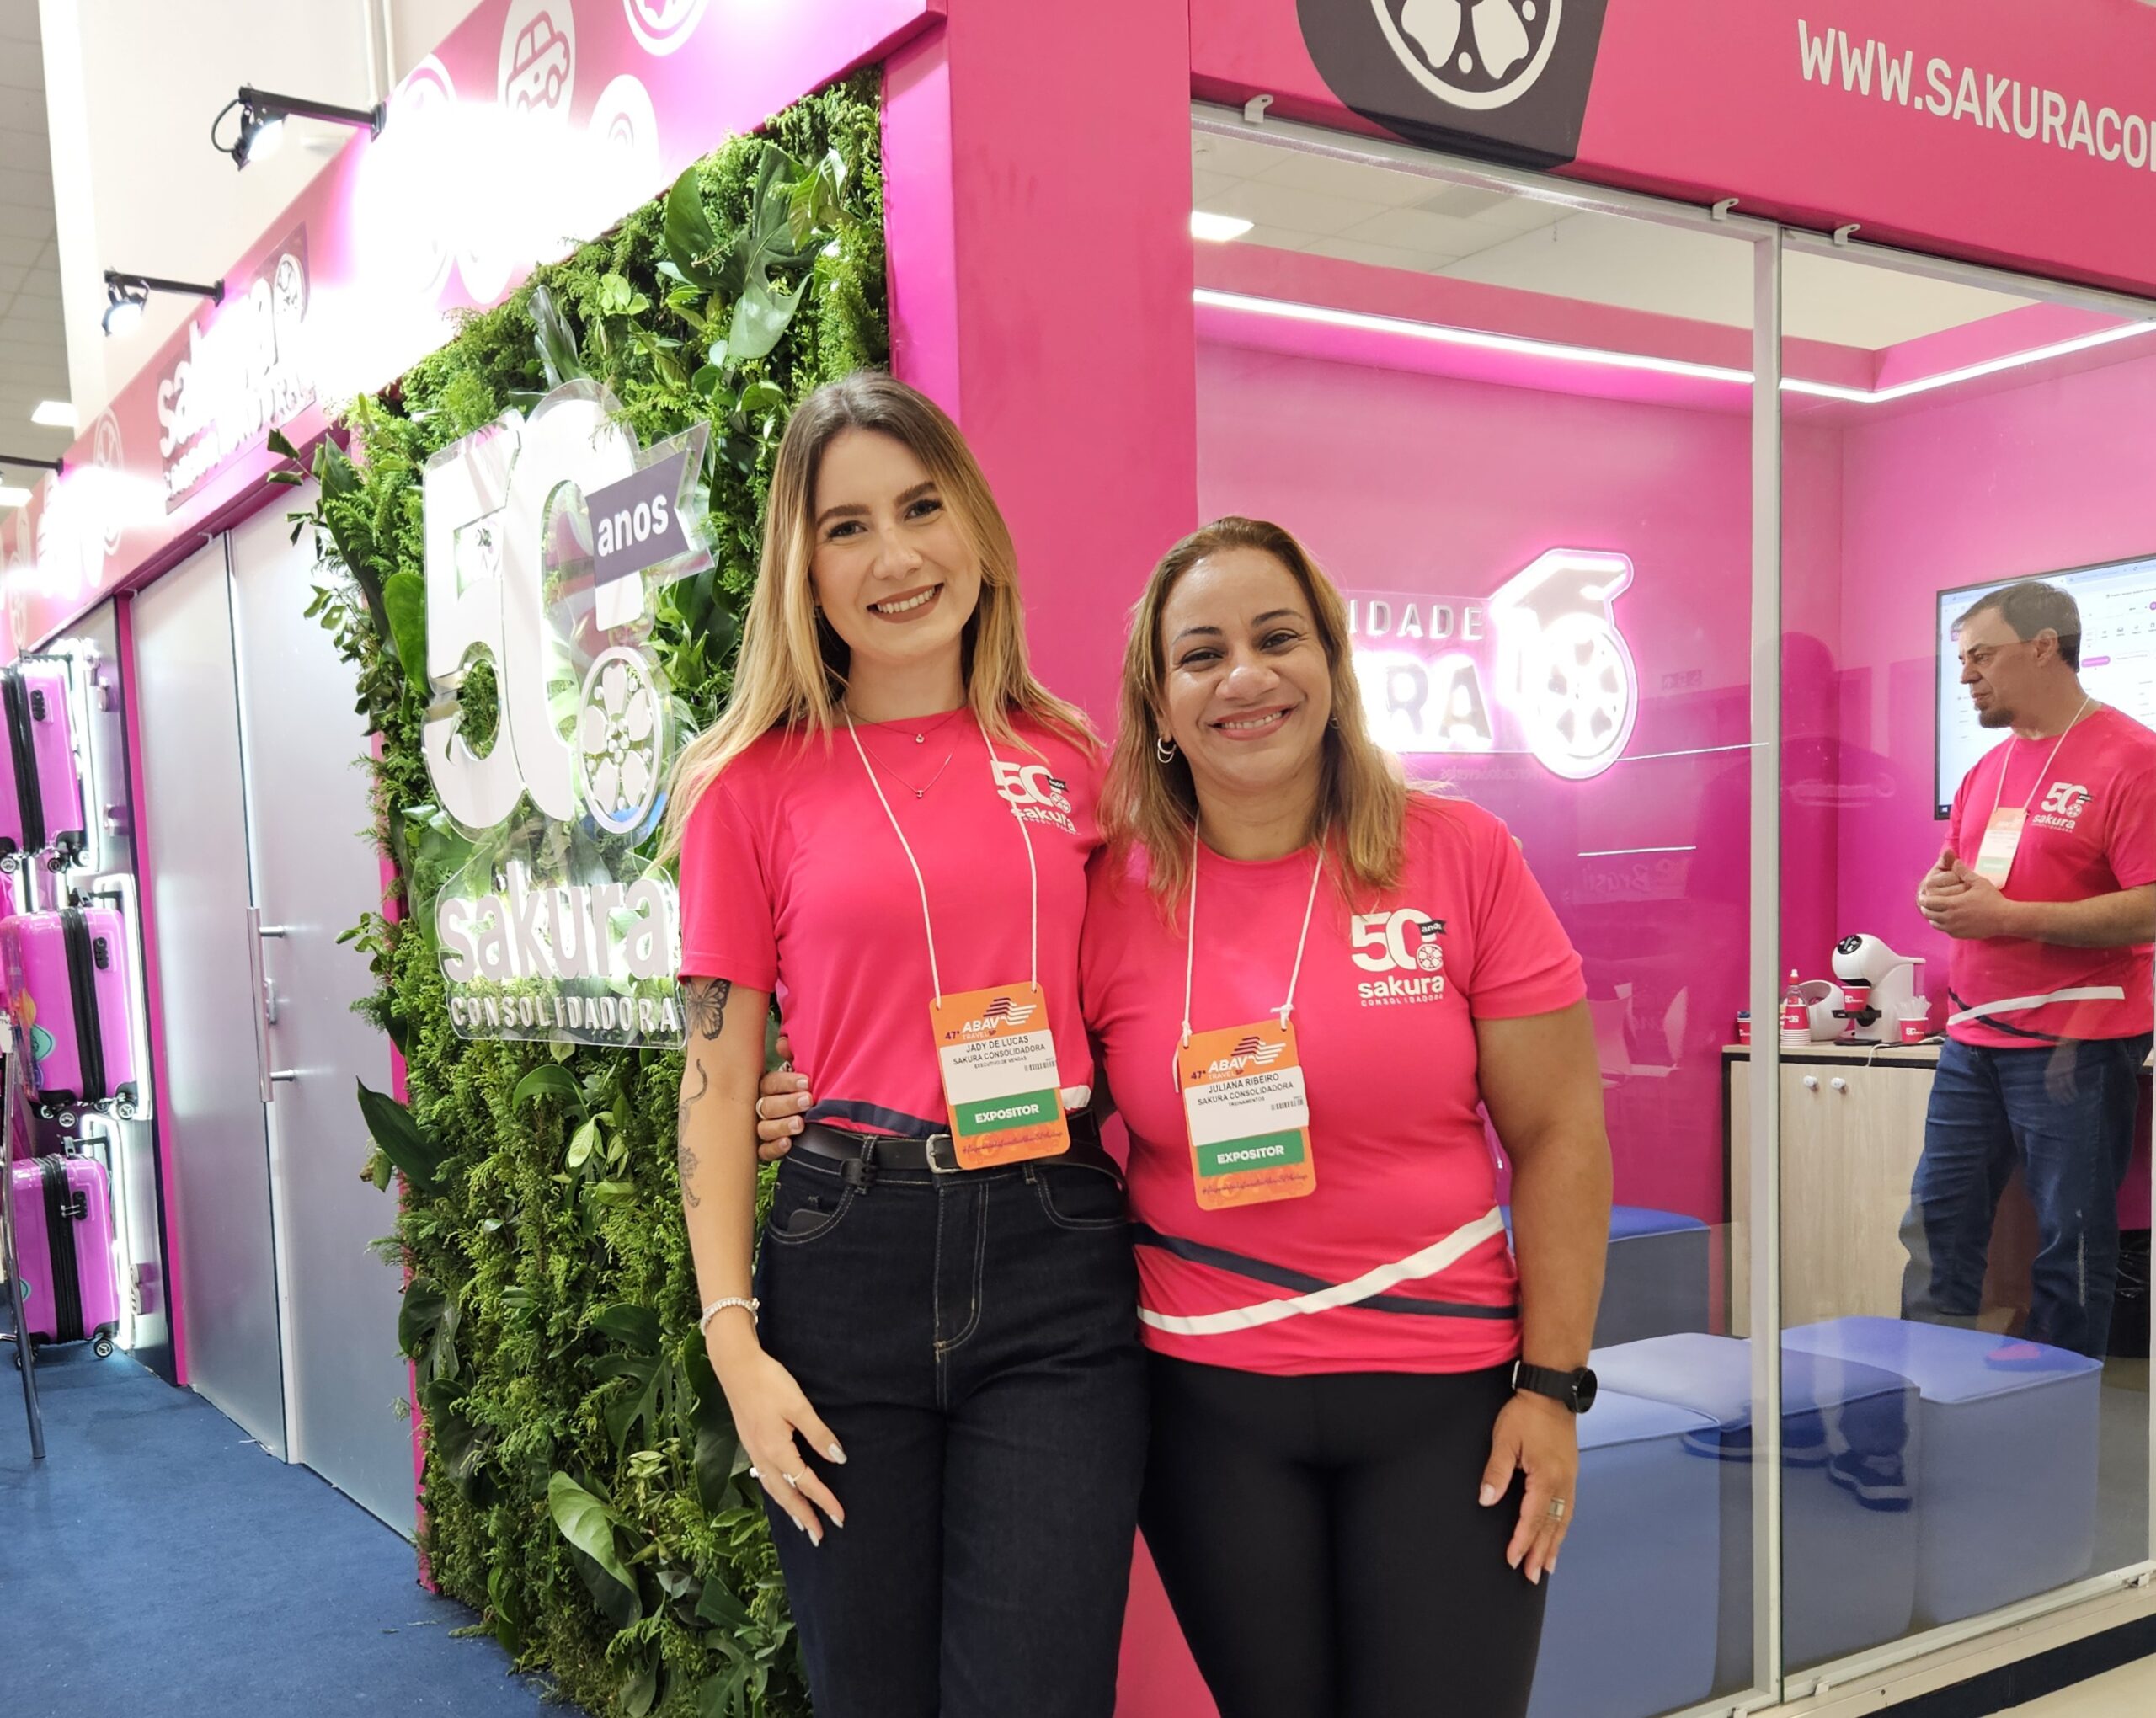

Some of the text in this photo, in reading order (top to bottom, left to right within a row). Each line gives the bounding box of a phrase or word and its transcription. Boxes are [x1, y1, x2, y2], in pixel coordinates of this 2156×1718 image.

[596, 493, 670, 558] anos
[2032, 814, 2076, 830] sakura
[439, 861, 670, 984] sakura
[1358, 975, 1444, 999] sakura
[450, 996, 682, 1033] CONSOLIDADORA
[962, 1016, 1000, 1034] ABAV
[953, 1044, 1046, 1066] SAKURA CONSOLIDADORA
[966, 1035, 1029, 1054] JADY DE LUCAS
[1208, 1056, 1247, 1074] ABAV
[1198, 1081, 1294, 1106] SAKURA CONSOLIDADORA
[1209, 1073, 1280, 1094] JULIANA RIBEIRO
[974, 1103, 1040, 1124] EXPOSITOR
[1217, 1144, 1285, 1166] EXPOSITOR
